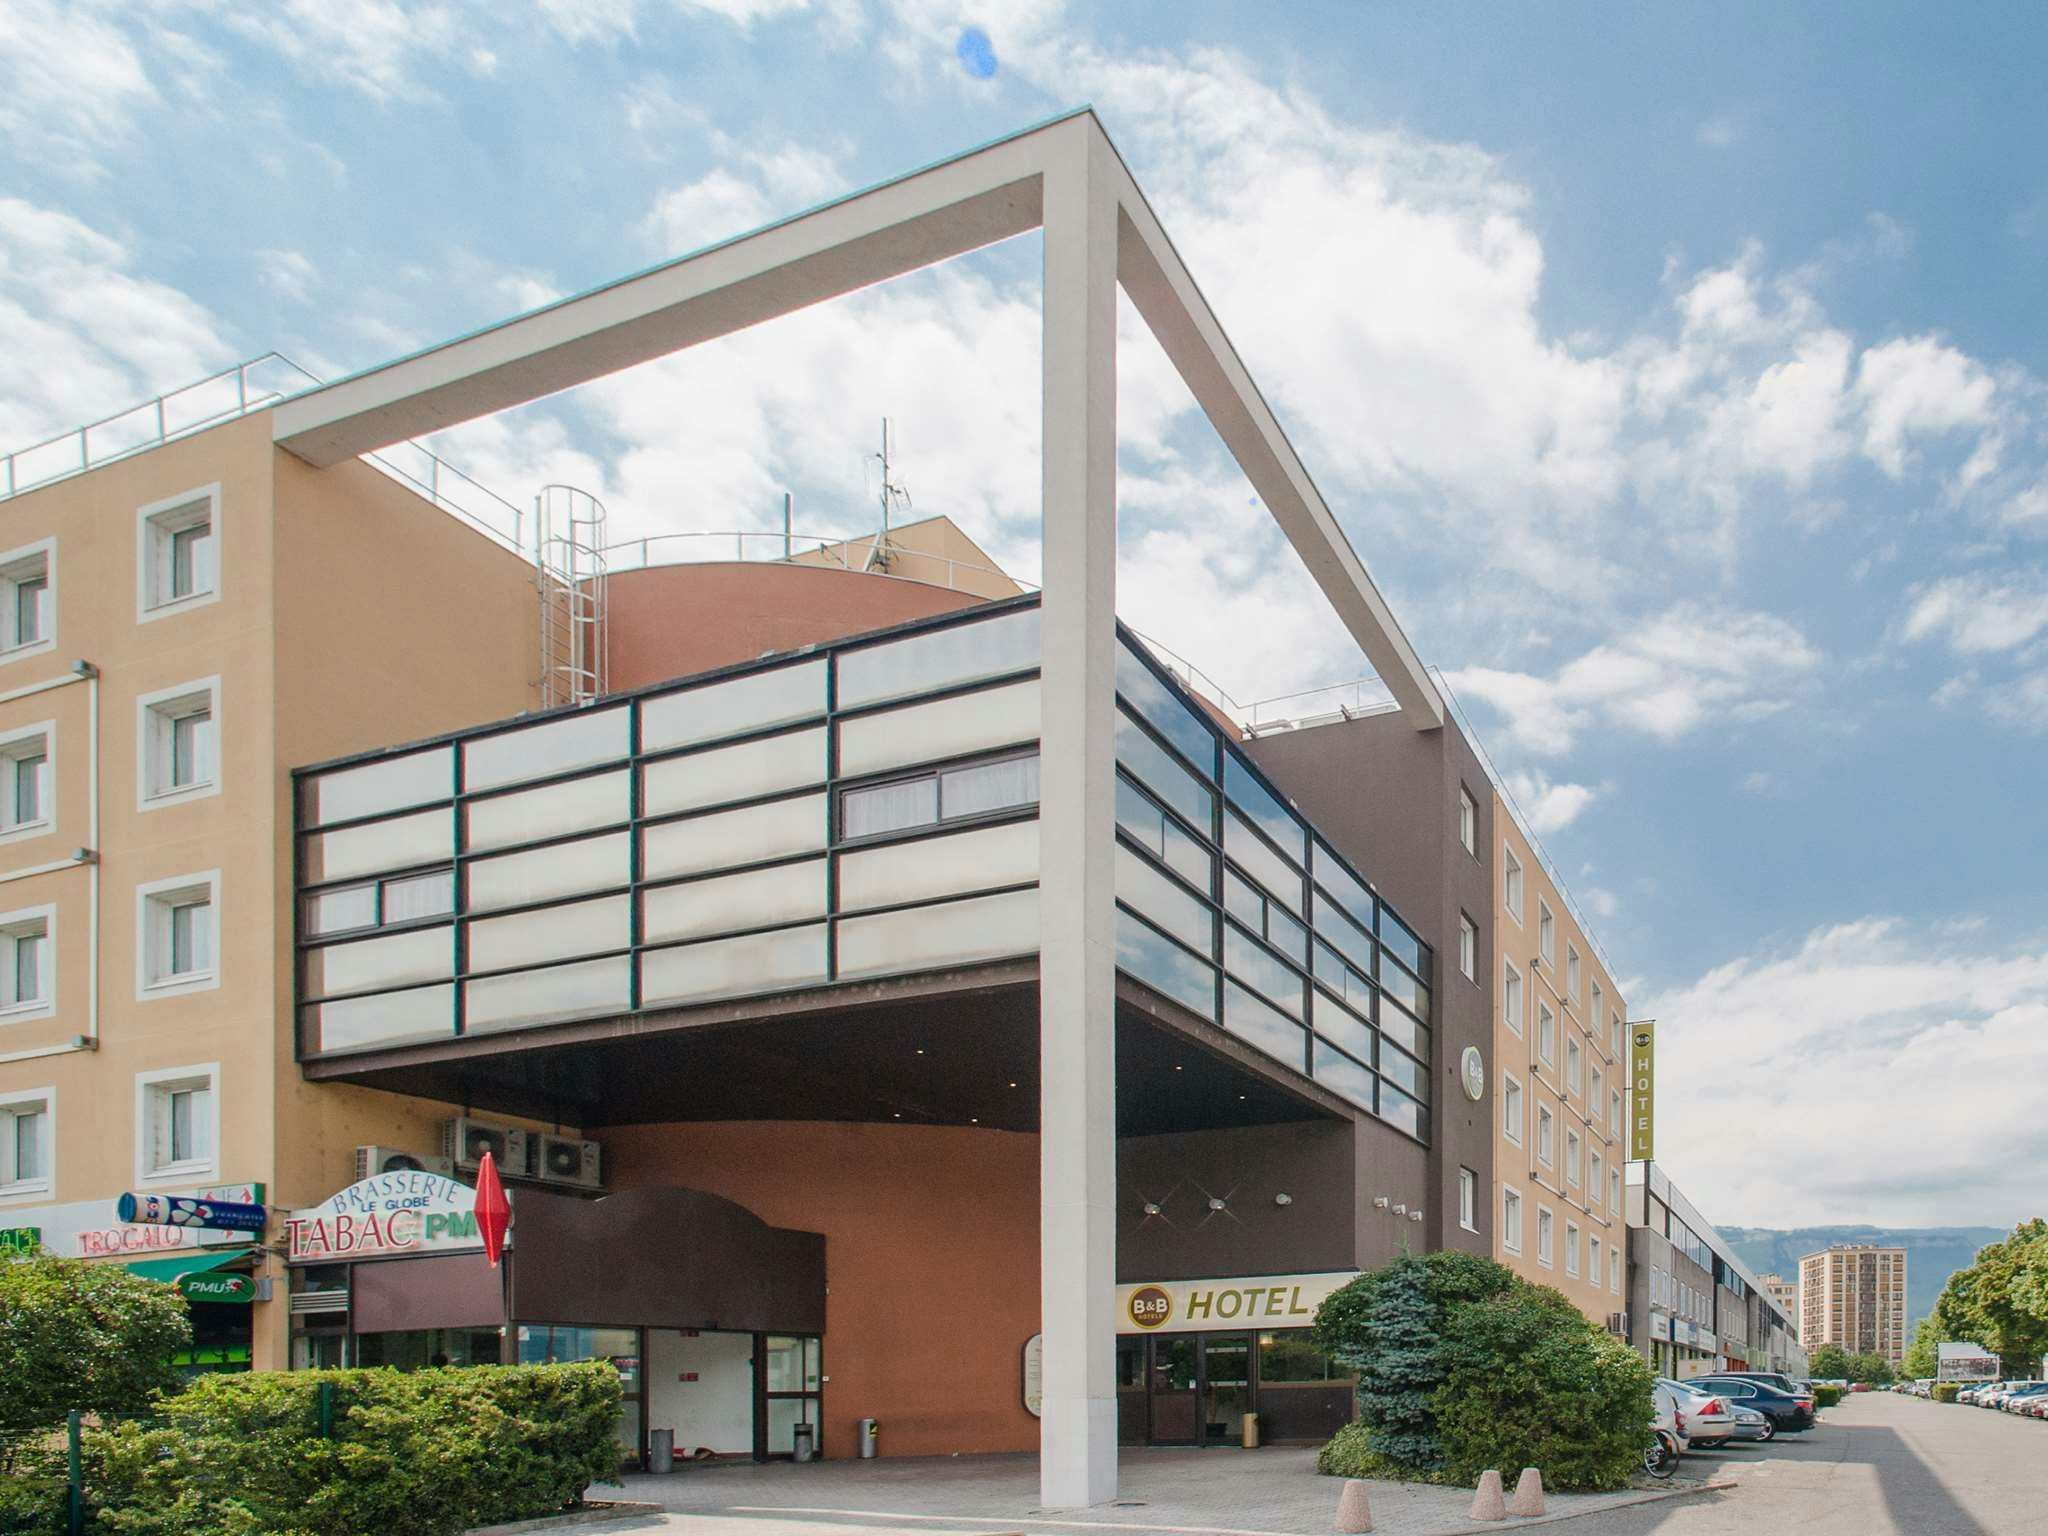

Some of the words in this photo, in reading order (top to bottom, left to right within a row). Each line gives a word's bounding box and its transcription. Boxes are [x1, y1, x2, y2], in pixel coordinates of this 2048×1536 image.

[1637, 1058, 1649, 1150] HOTEL
[332, 1173, 460, 1214] BRASSERIE
[361, 1202, 376, 1213] LE
[385, 1196, 430, 1211] GLOBE
[285, 1209, 413, 1256] TABAC
[425, 1210, 478, 1240] PM
[188, 1281, 225, 1293] PMU
[1186, 1286, 1308, 1320] HOTEL
[1134, 1298, 1168, 1314] B&B
